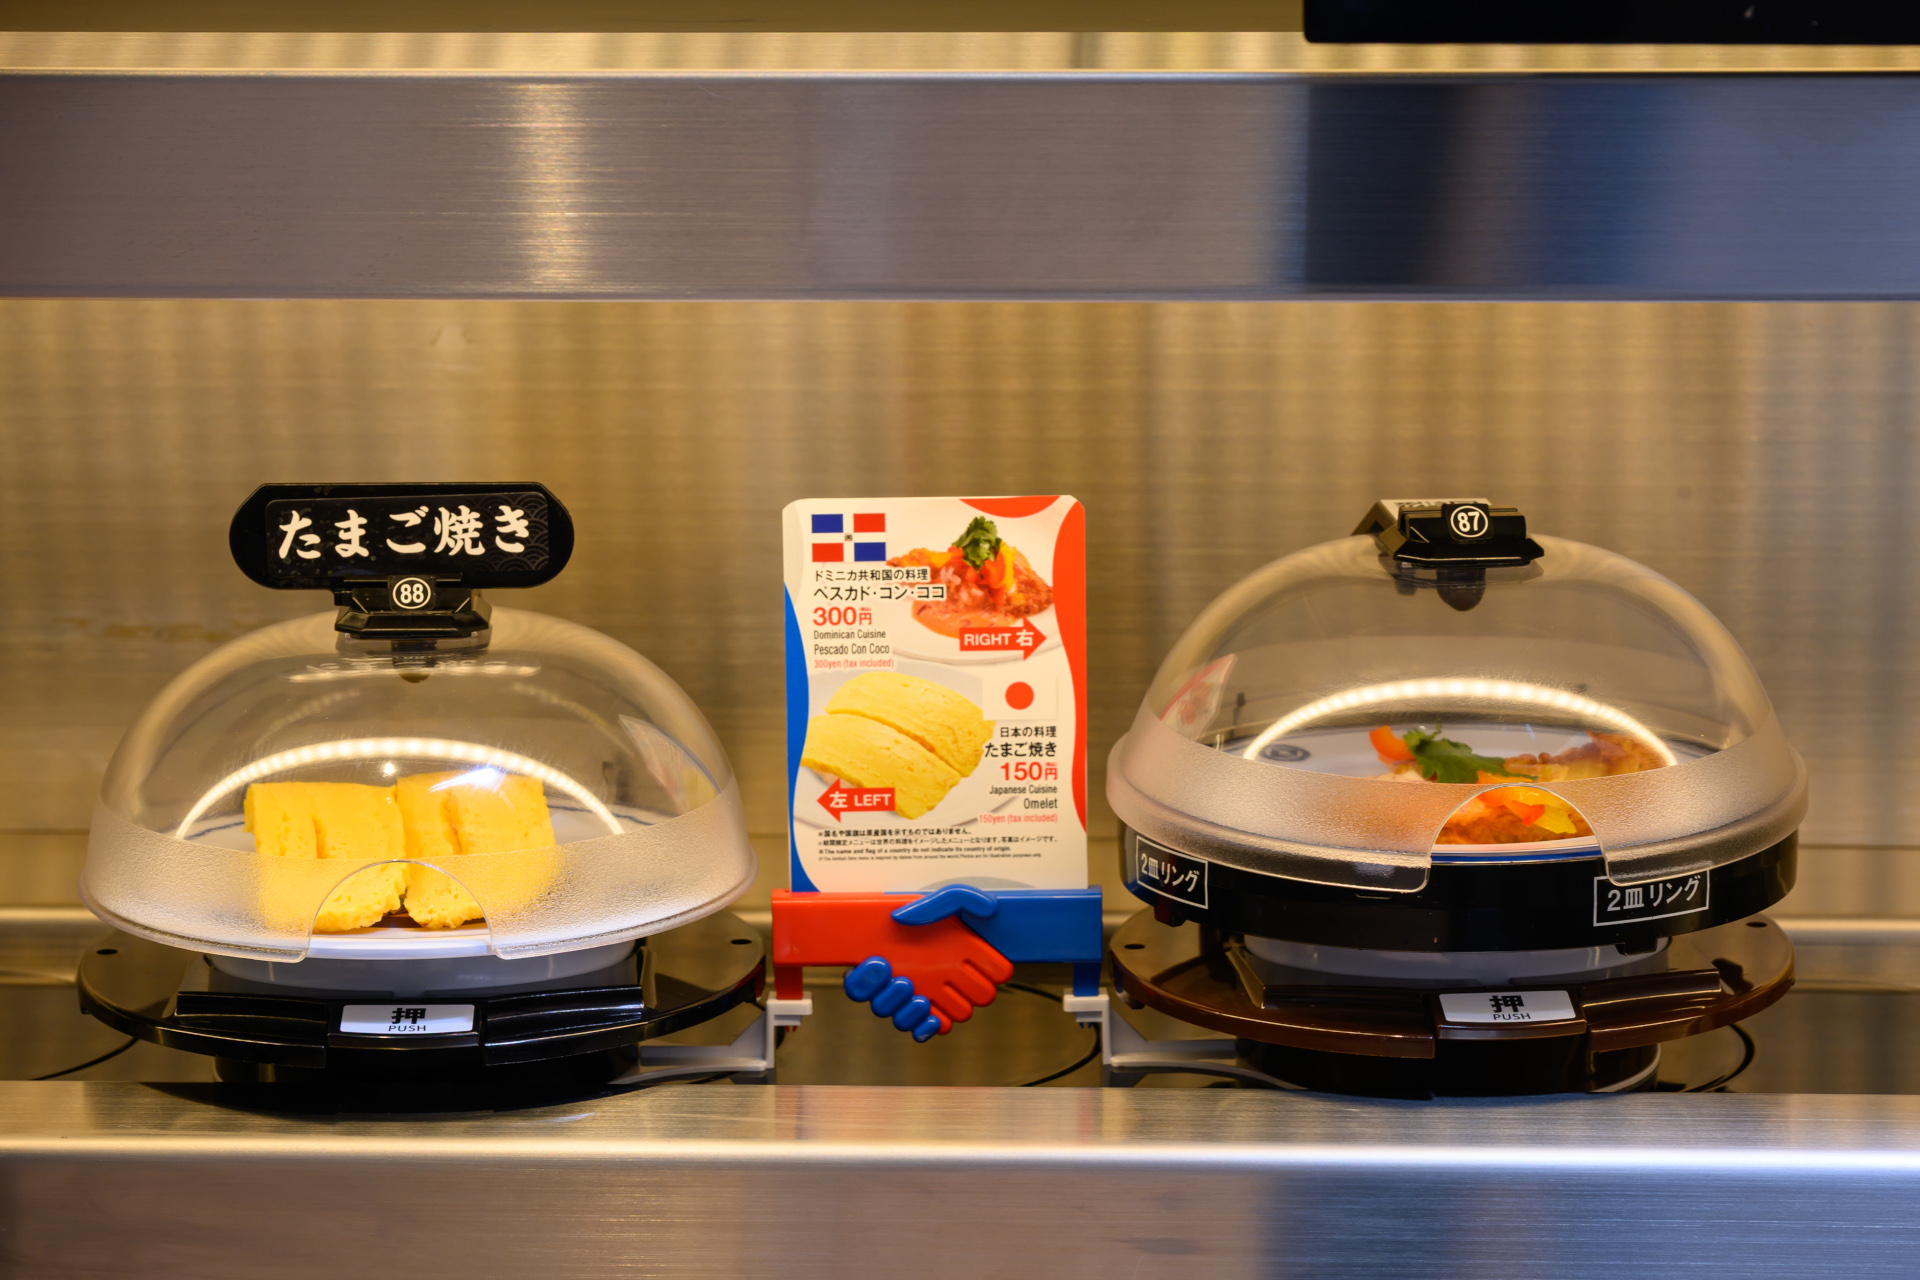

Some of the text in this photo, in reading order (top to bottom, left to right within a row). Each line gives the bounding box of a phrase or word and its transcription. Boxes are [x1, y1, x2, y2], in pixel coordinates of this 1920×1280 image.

[1457, 511, 1481, 533] 87
[278, 505, 530, 560] たまご焼き
[815, 568, 929, 582] ドミニカ共和国の料理
[399, 583, 425, 604] 88
[813, 585, 945, 601] ペスカド・コン・ココ
[813, 629, 886, 640] Dominican Cuisine
[963, 632, 1011, 647] RIGHT
[1015, 629, 1034, 647] 右
[814, 643, 890, 655] Pescado Con Coco
[814, 658, 894, 670] 300yen (tax included)
[1000, 725, 1057, 738] 日本の料理
[984, 742, 1057, 758] たまご焼き
[989, 784, 1058, 796] Japanese Cuisine
[829, 791, 849, 809] 左
[854, 794, 892, 807] LEFT
[1023, 797, 1058, 809] Omelet
[979, 812, 1058, 825] 150yen (tax included)
[1141, 852, 1200, 893] 2皿リング
[1606, 874, 1701, 912] 2皿リング
[1489, 995, 1525, 1013] 押
[391, 1007, 427, 1025] 押
[1493, 1012, 1532, 1021] PUSH
